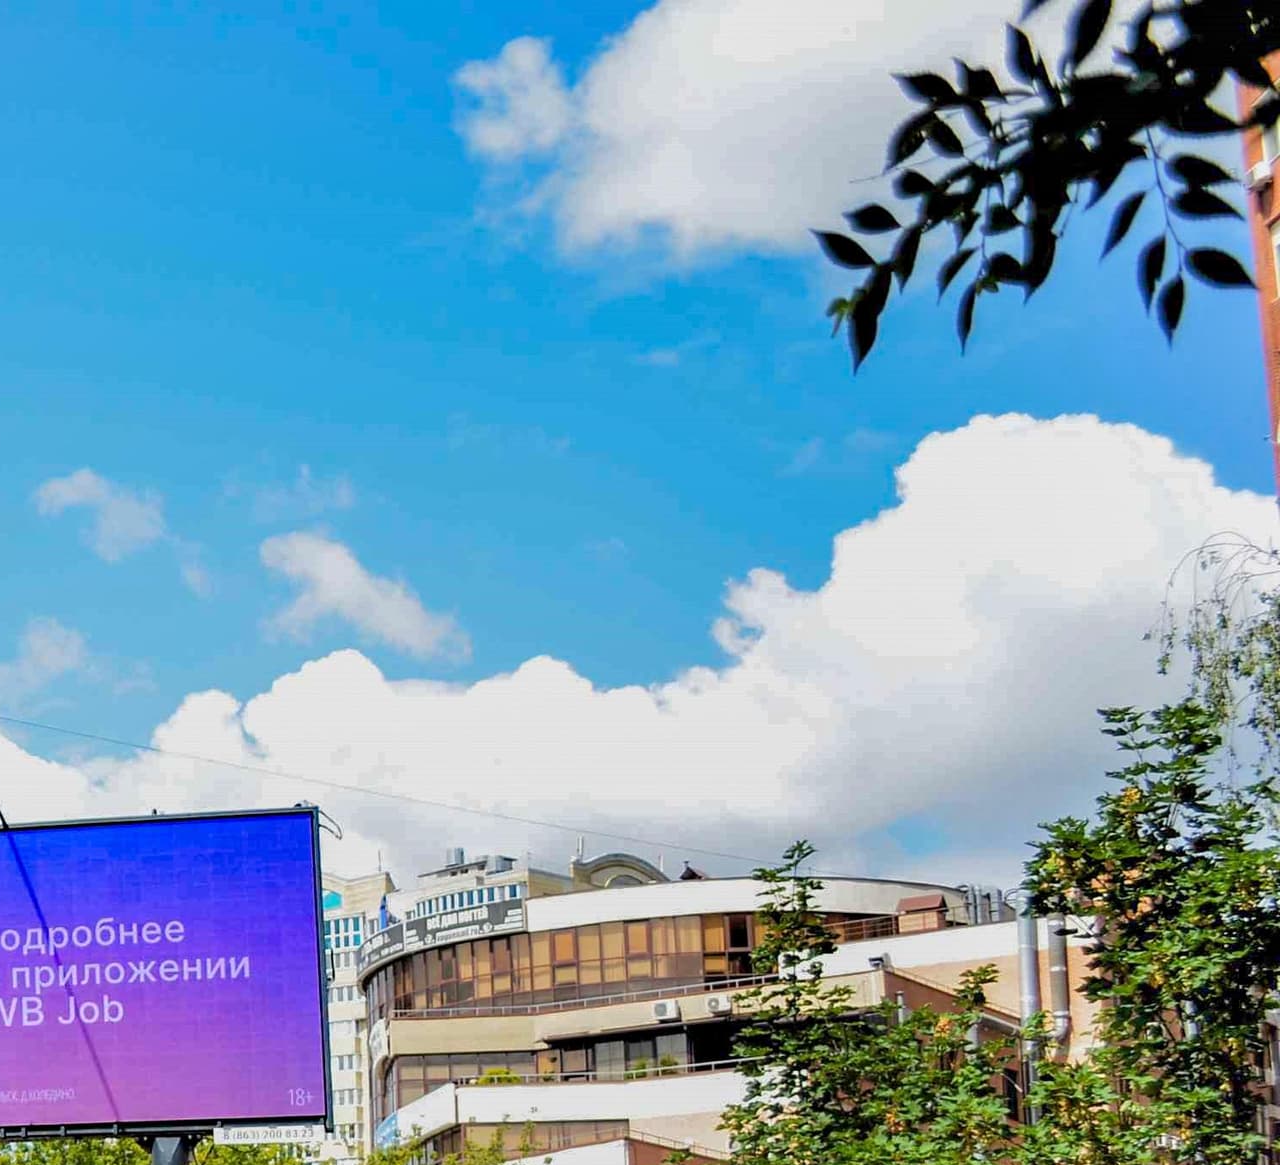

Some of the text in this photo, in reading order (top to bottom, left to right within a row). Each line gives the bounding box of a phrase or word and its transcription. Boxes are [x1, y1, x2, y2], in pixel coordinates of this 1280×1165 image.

[12, 956, 251, 995] приложении
[58, 994, 125, 1025] Job
[288, 1087, 313, 1107] 18+
